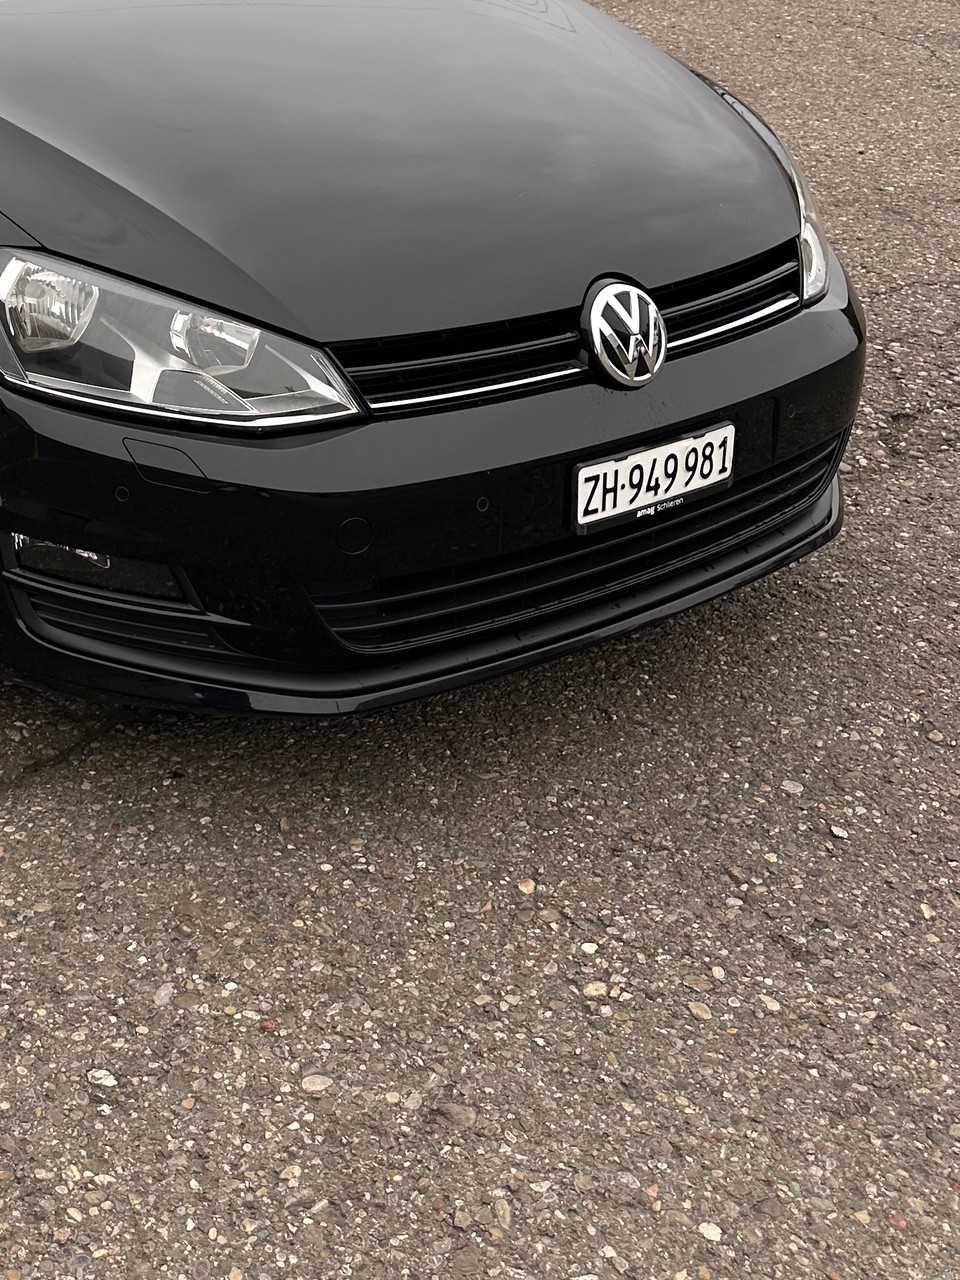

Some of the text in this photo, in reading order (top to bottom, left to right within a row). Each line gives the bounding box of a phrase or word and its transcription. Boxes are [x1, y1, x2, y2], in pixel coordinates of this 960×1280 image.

[684, 436, 728, 487] 981
[636, 497, 684, 518] amag Schlieren
